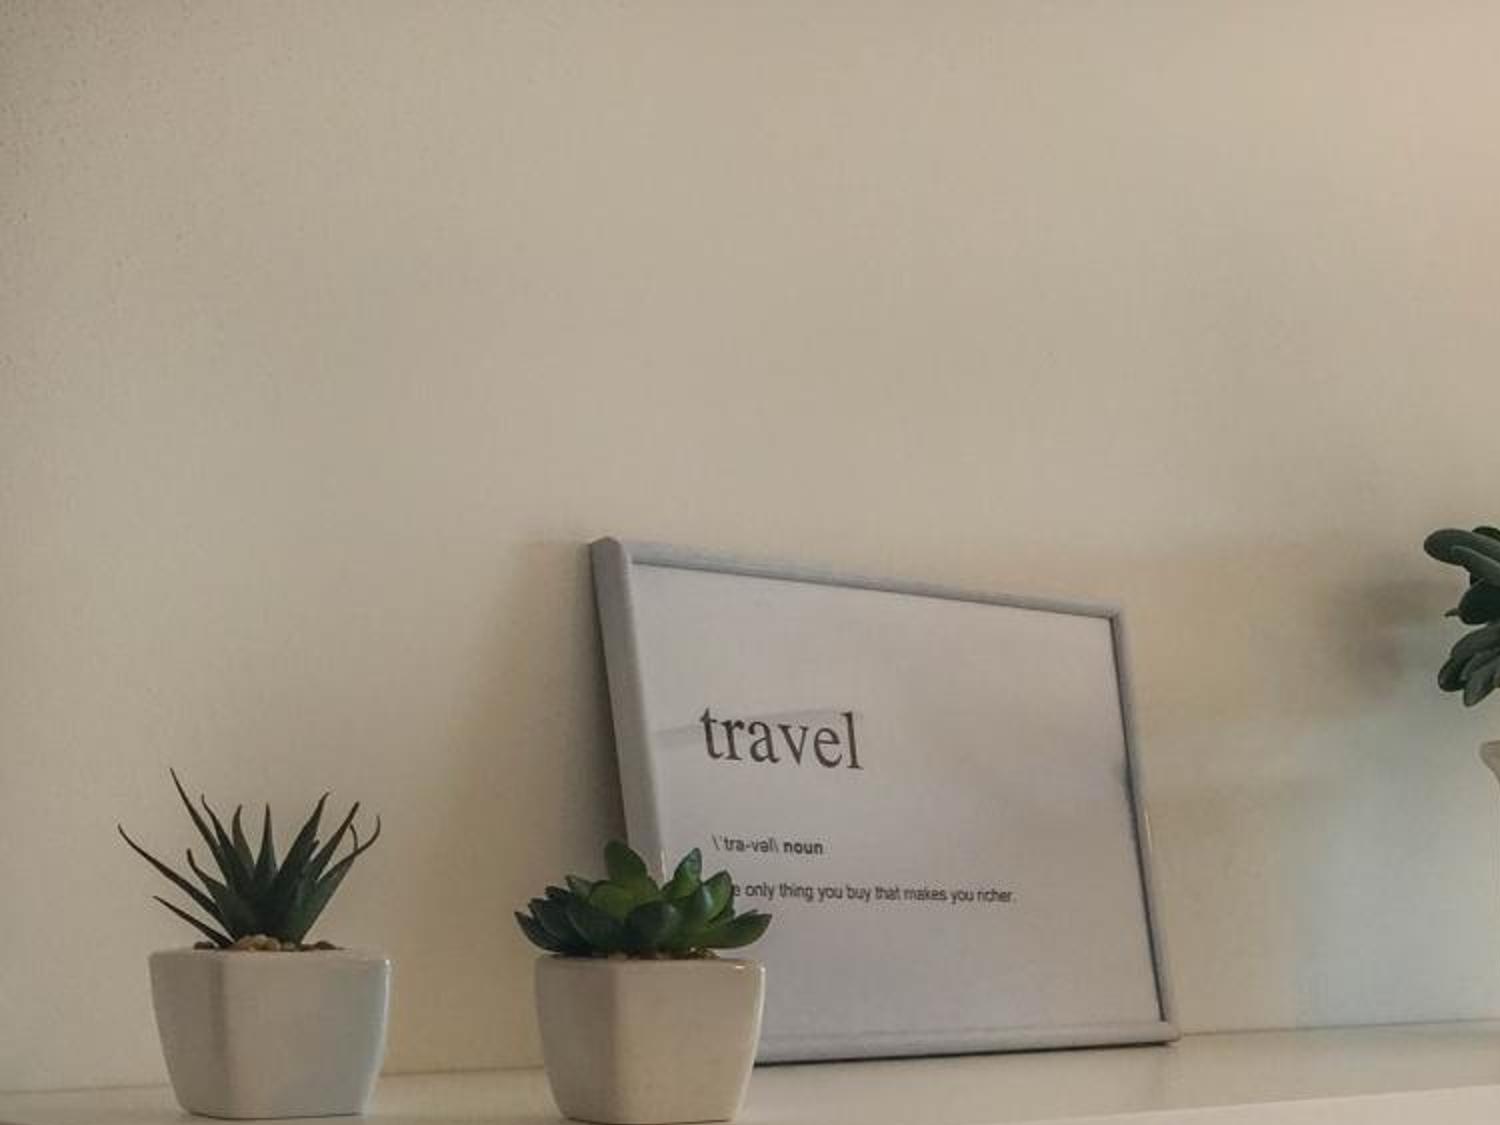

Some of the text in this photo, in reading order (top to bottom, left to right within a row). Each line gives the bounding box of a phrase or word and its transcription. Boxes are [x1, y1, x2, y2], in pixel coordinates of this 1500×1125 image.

[700, 707, 864, 769] travel
[783, 841, 823, 854] noun
[745, 881, 775, 900] only
[779, 882, 814, 902] thing
[818, 887, 843, 902] you
[846, 884, 870, 902] buy
[875, 885, 900, 900] that
[904, 887, 947, 901] makes
[950, 890, 974, 904] you
